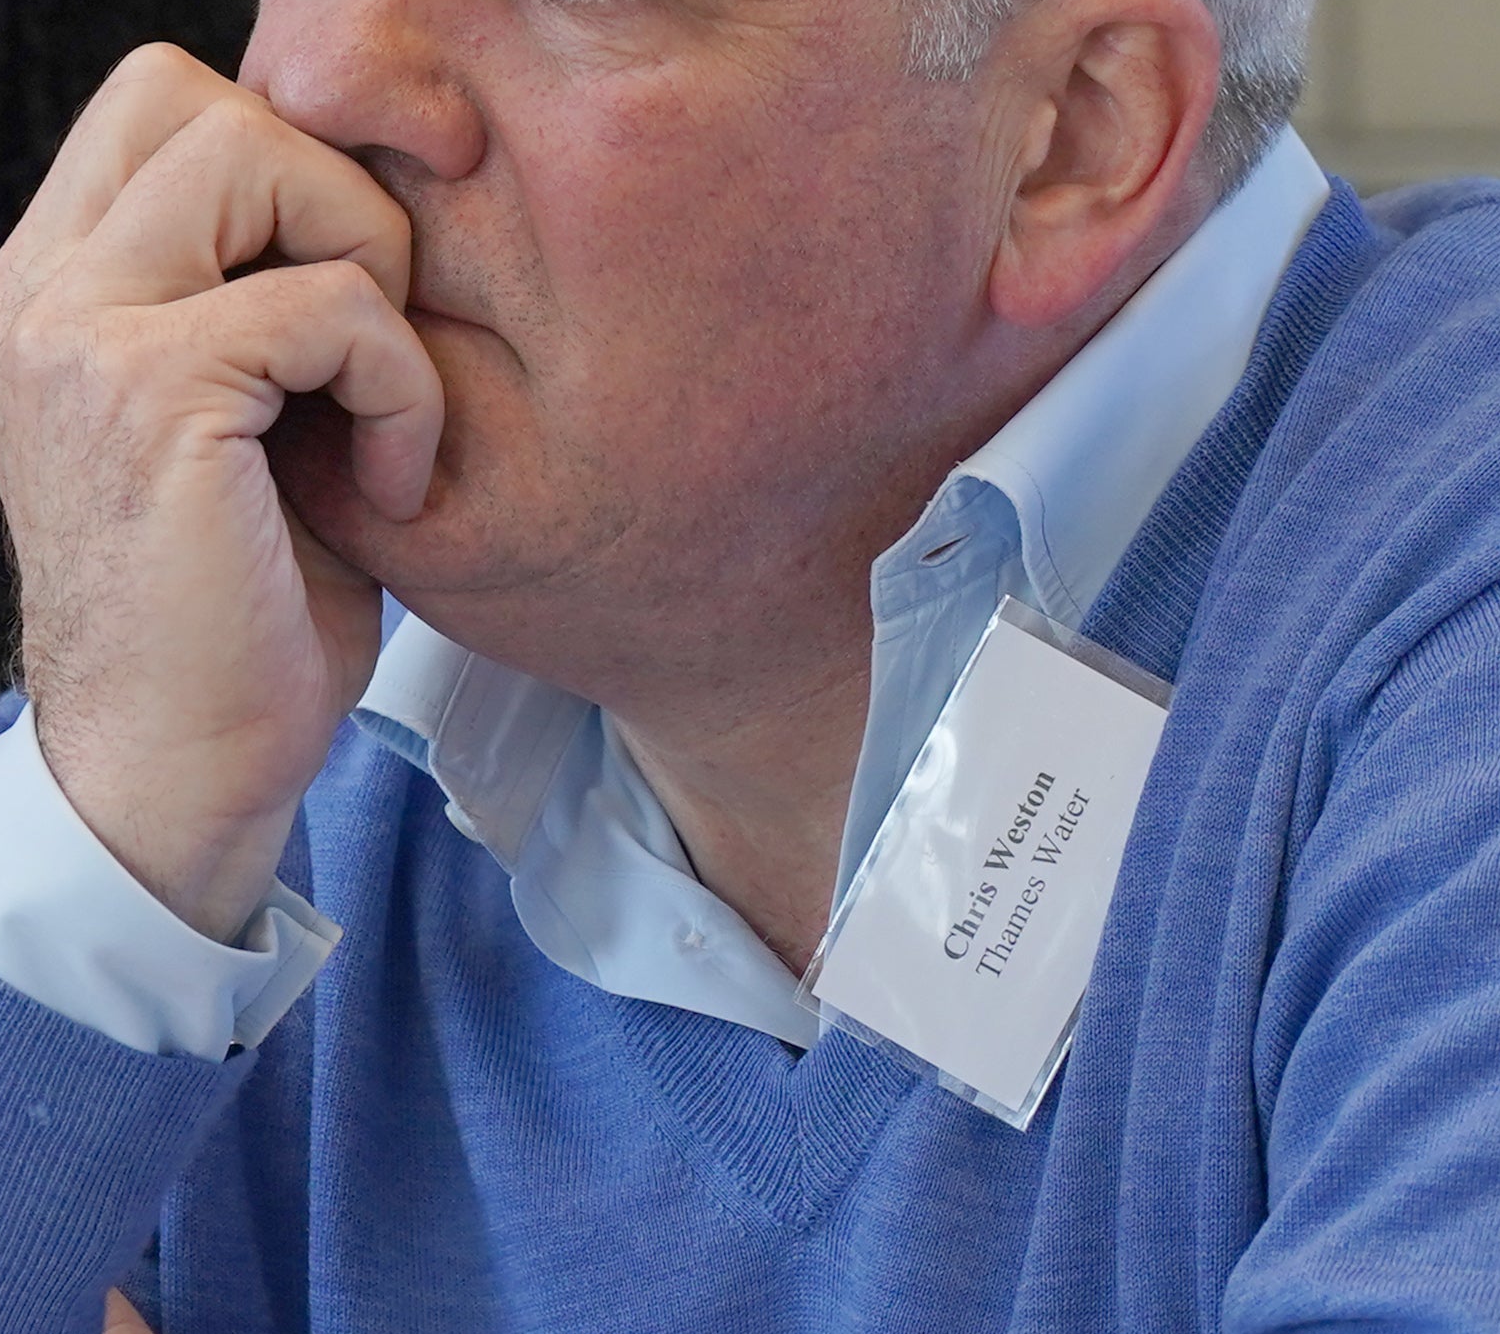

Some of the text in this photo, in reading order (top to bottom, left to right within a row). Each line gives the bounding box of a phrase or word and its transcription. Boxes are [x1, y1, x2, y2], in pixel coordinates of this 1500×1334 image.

[943, 770, 1057, 961] Chris Weston
[975, 787, 1091, 979] Thames Water
